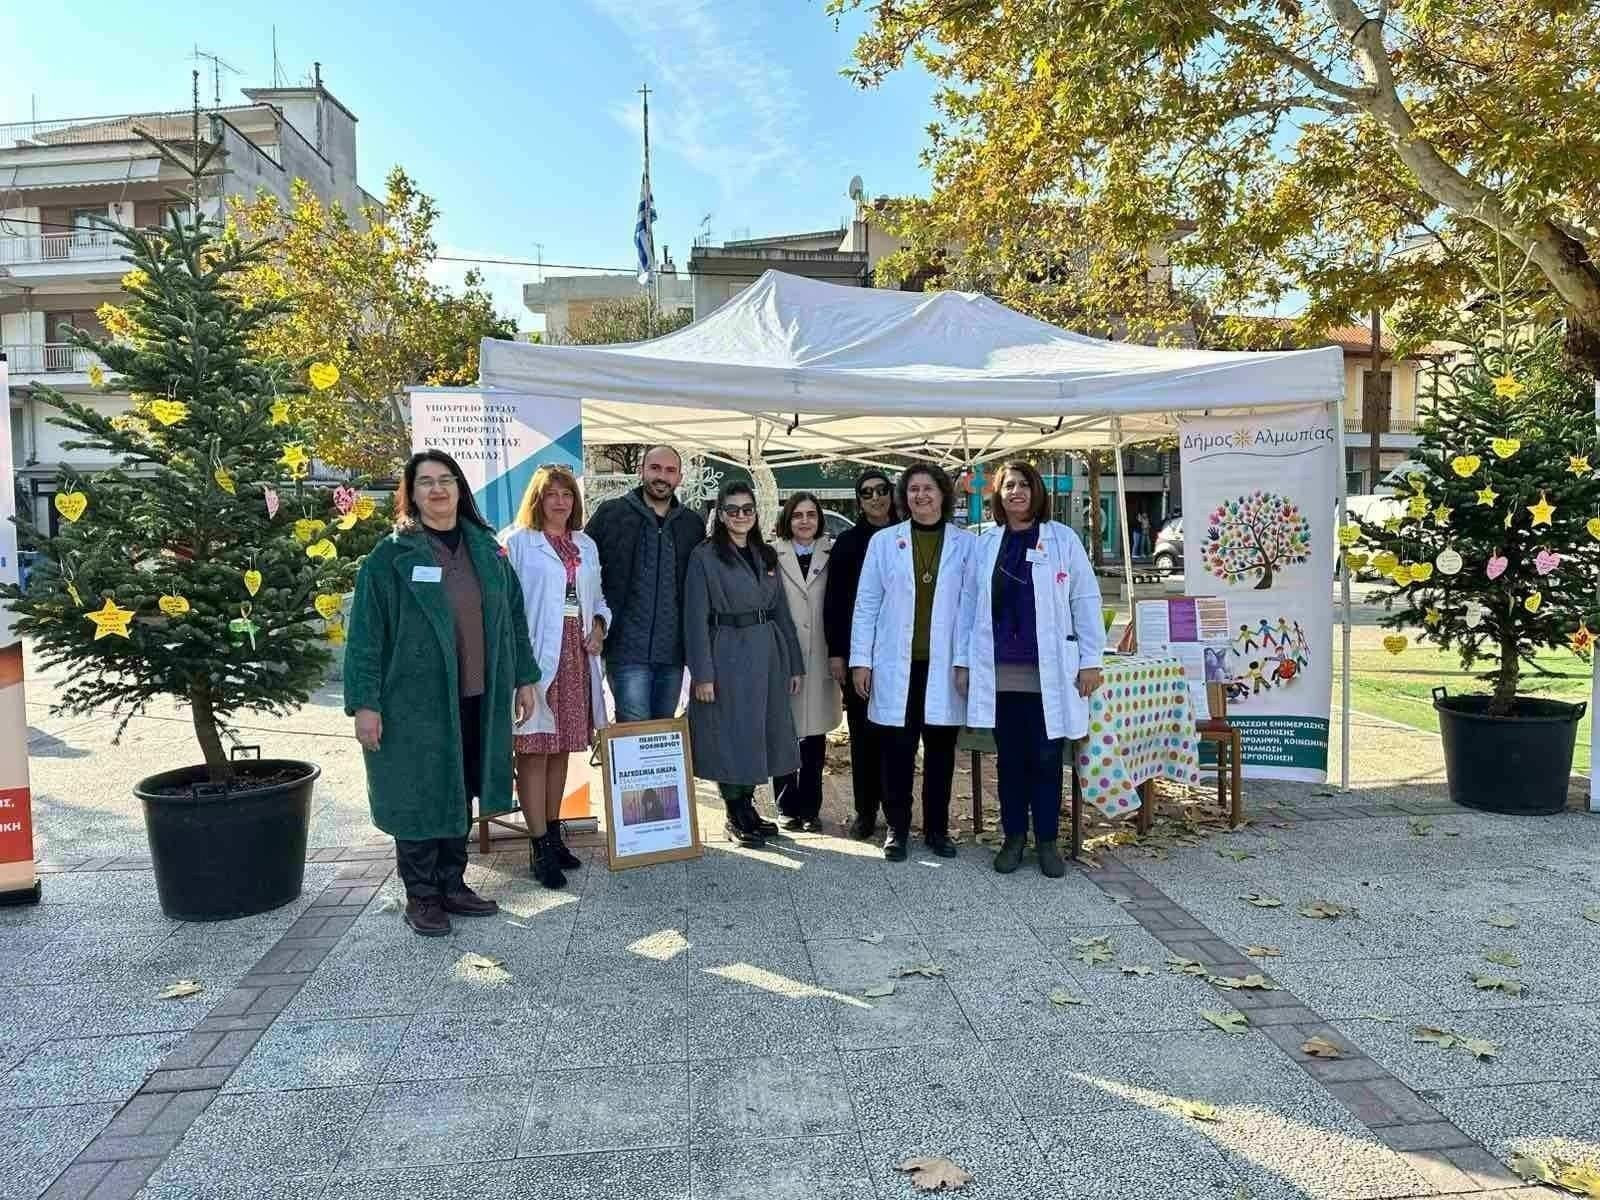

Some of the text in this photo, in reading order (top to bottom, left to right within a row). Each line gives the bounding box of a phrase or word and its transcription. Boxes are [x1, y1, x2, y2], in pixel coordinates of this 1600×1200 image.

[425, 404, 518, 413] ΥΠΟΥΡΓΕΙΟ ΥΓΕΙΑΣ
[444, 415, 513, 424] ΥΓΕΙΟΝΟΜΙΚΗ
[443, 425, 502, 434] ΠΕΡΙΦΕΡΕΙΑ
[424, 437, 521, 448] ΚΕΝΤΡΟ ΥΓΕΙΑΣ
[1184, 426, 1337, 452] Δήμος Αλμωπίας
